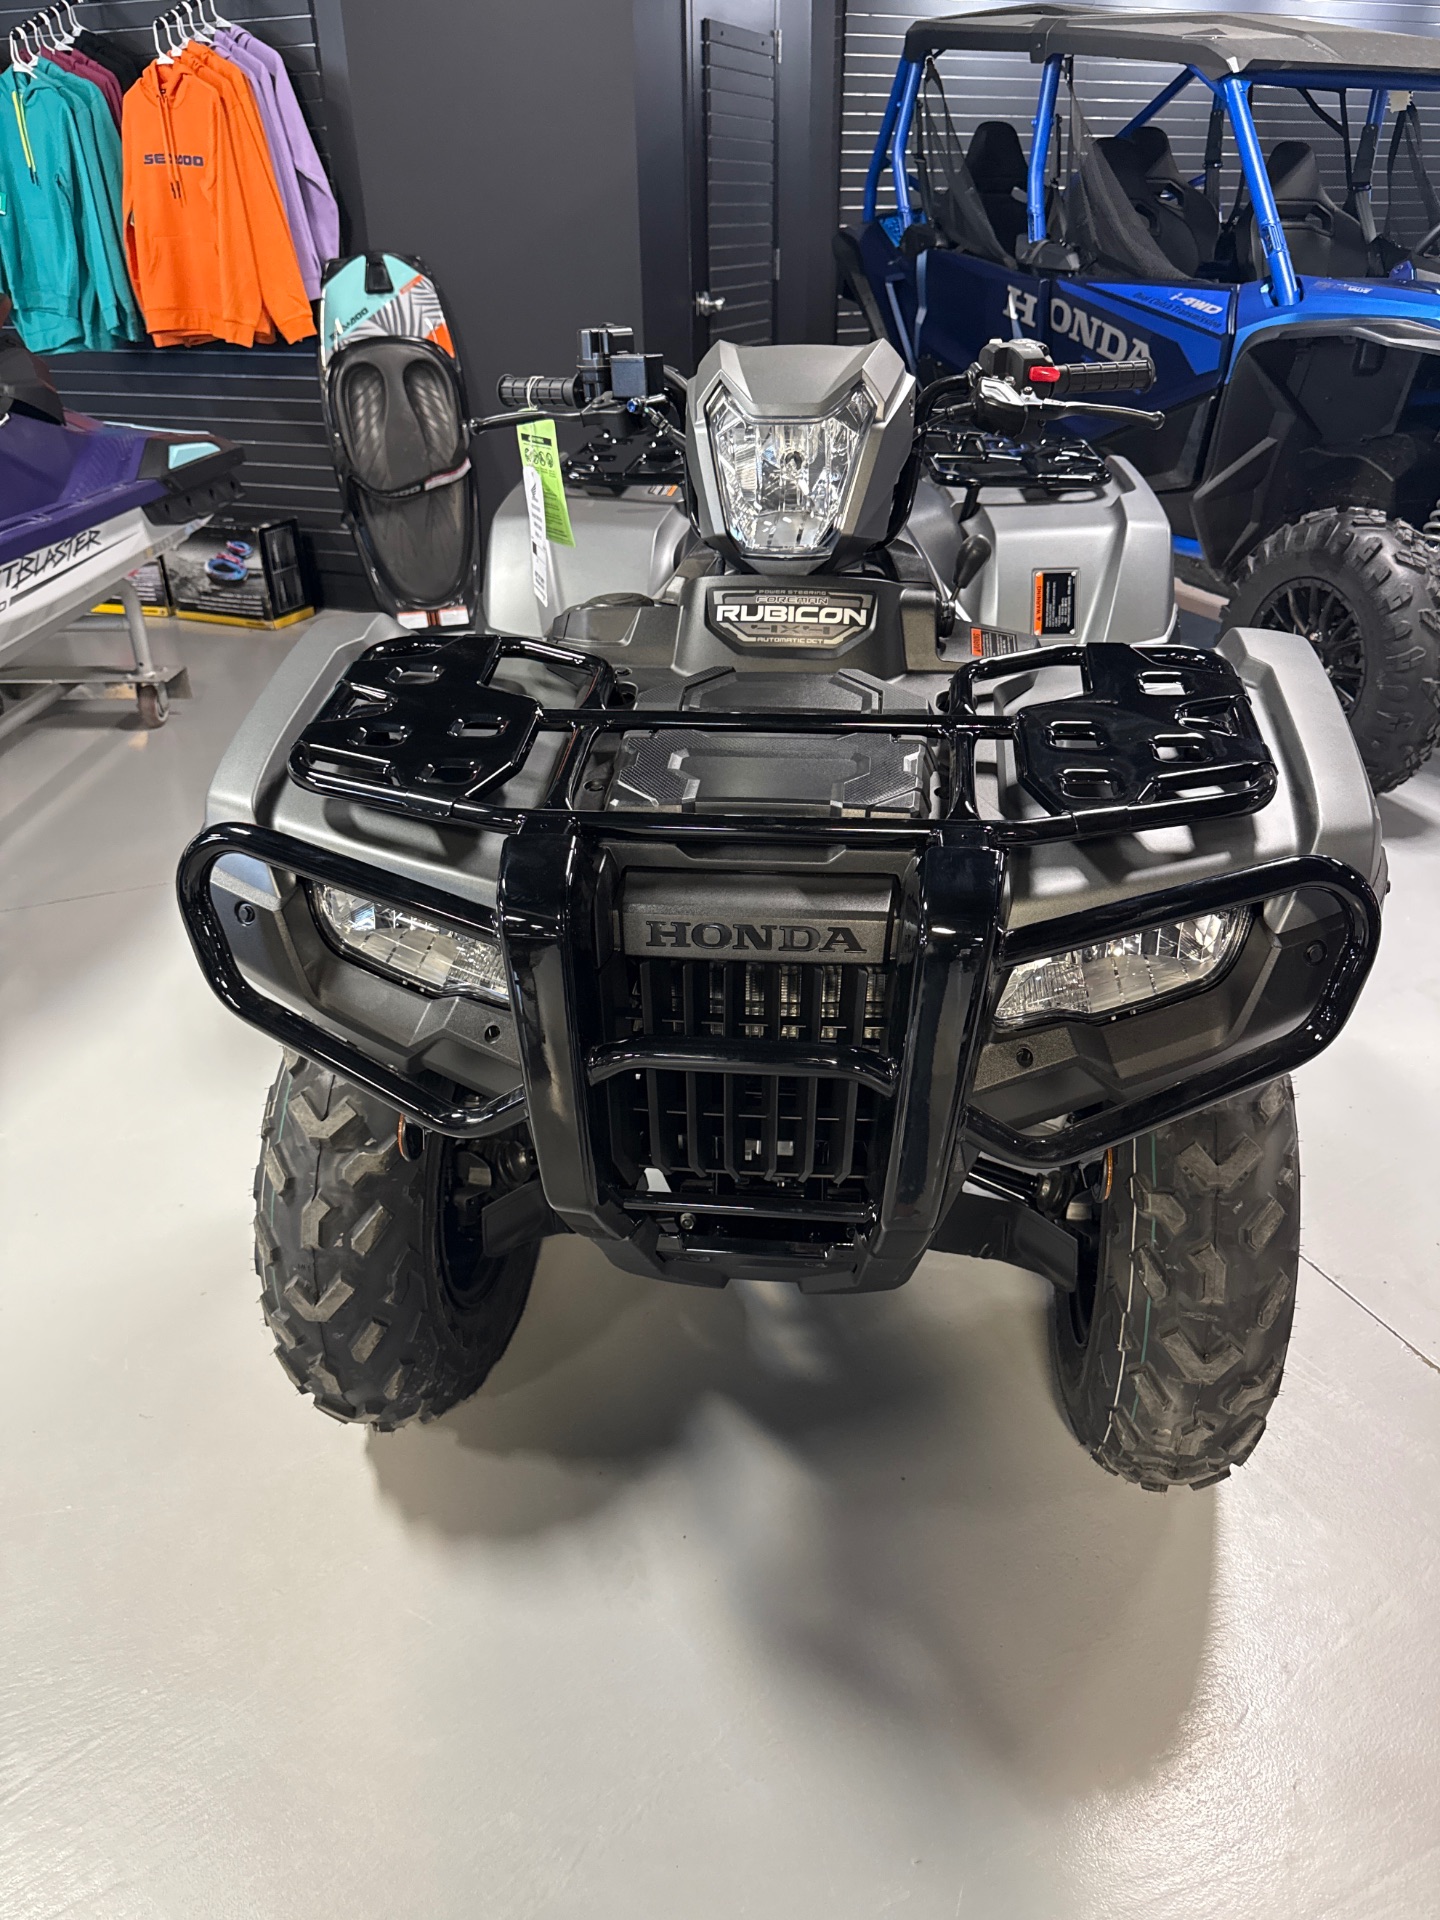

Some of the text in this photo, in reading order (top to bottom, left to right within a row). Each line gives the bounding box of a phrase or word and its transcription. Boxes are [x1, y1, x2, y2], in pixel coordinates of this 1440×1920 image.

[1002, 284, 1152, 362] HONDA
[755, 595, 829, 605] FOREMAN
[716, 605, 867, 626] RUBICON
[645, 920, 867, 954] HONDA
